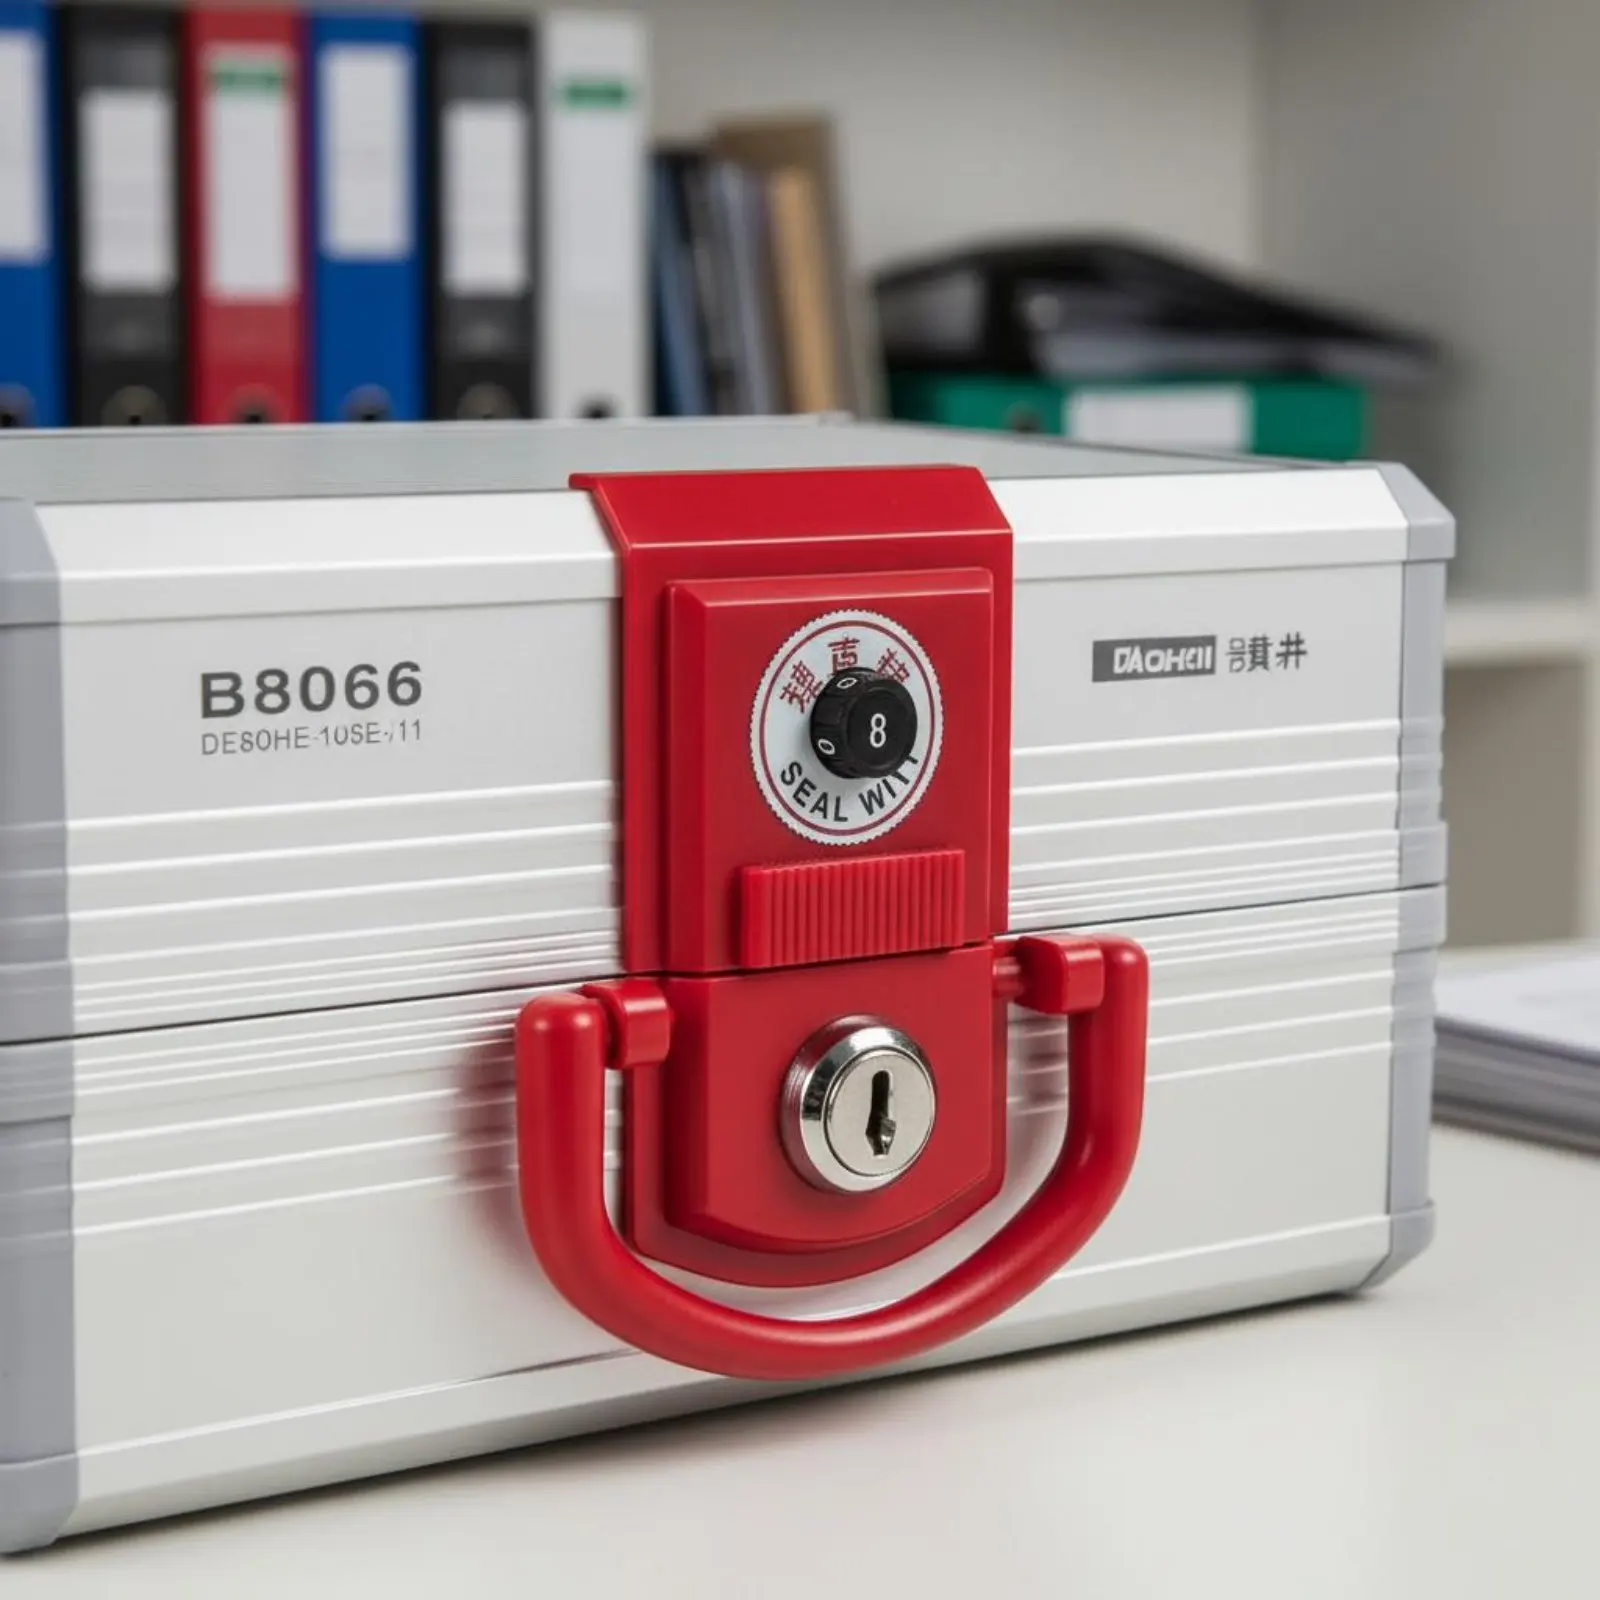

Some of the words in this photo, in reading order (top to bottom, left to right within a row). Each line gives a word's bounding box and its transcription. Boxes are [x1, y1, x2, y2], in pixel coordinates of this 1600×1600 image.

[200, 661, 422, 719] B8066
[869, 713, 887, 748] 8
[780, 761, 849, 822] SEAL
